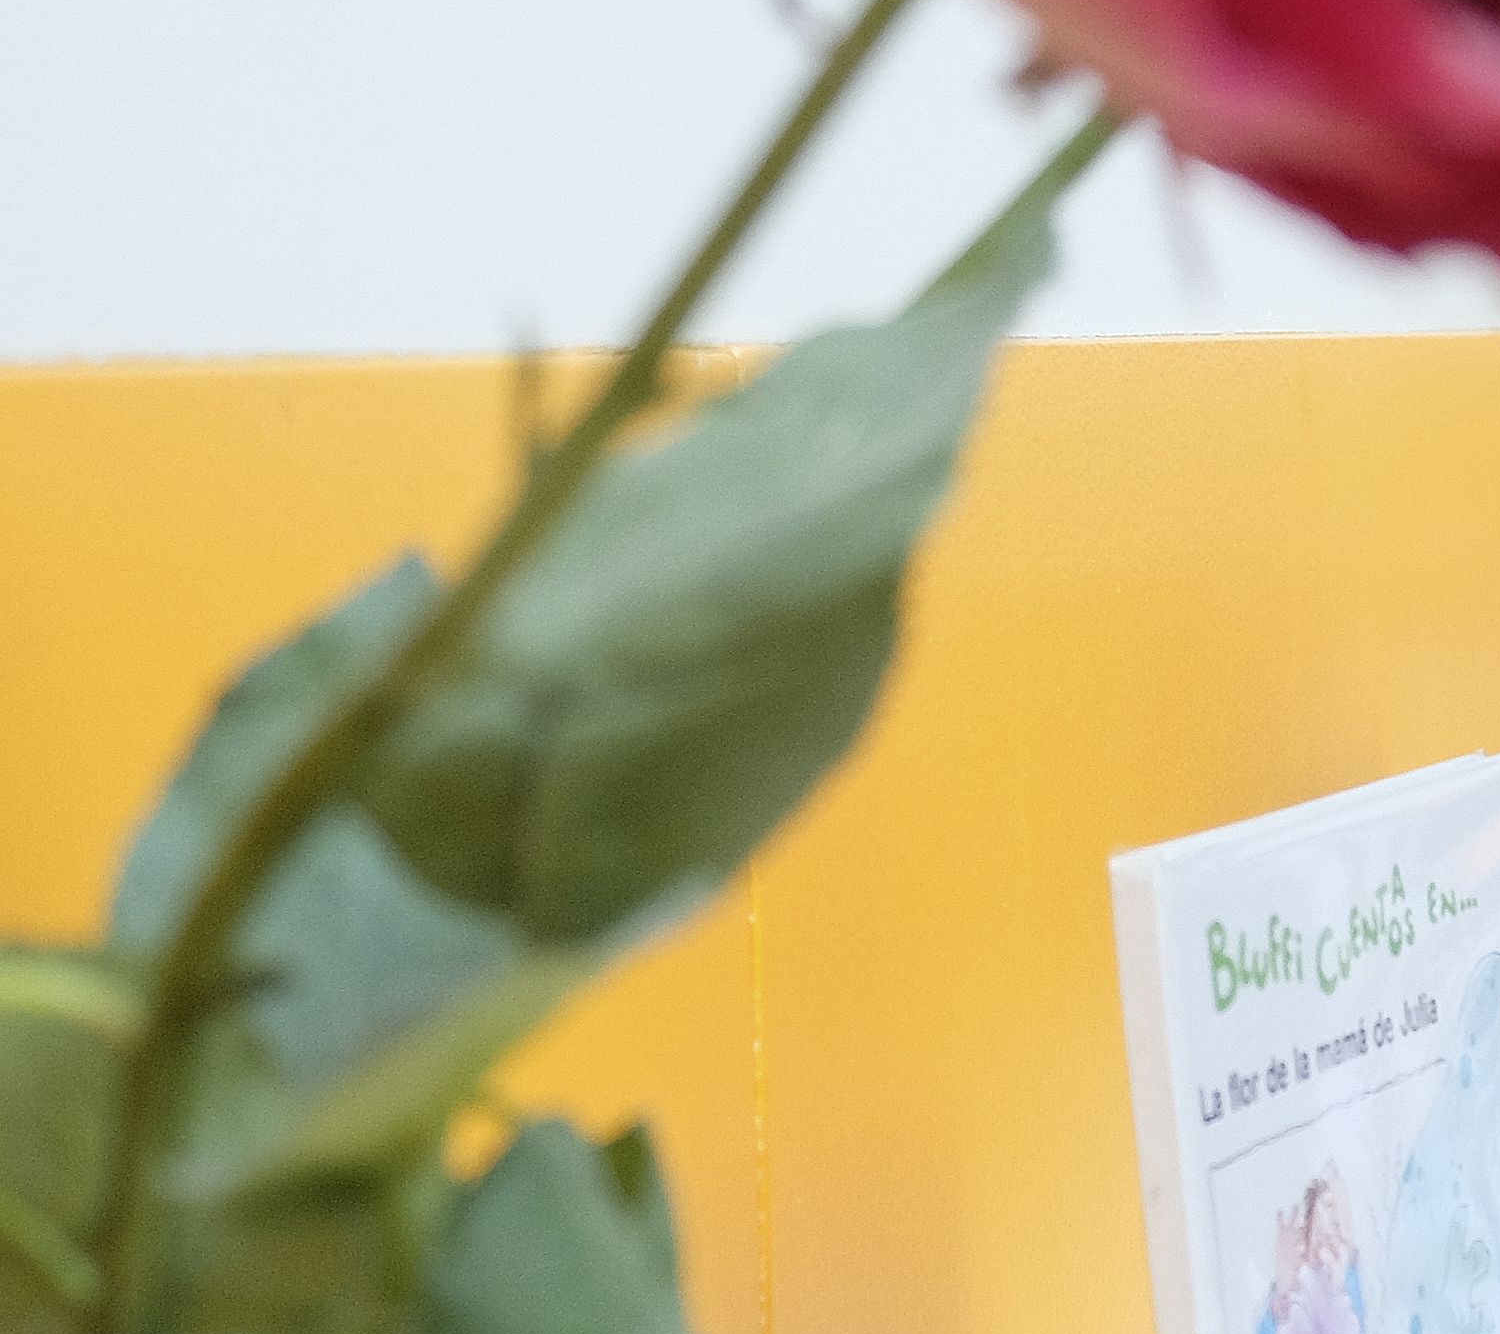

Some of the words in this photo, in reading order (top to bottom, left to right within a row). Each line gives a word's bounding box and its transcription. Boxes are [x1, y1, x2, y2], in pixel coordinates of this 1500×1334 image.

[1198, 1082, 1224, 1127] La
[1265, 1055, 1289, 1096] de
[1292, 1045, 1312, 1083] la
[1373, 1010, 1395, 1049] de
